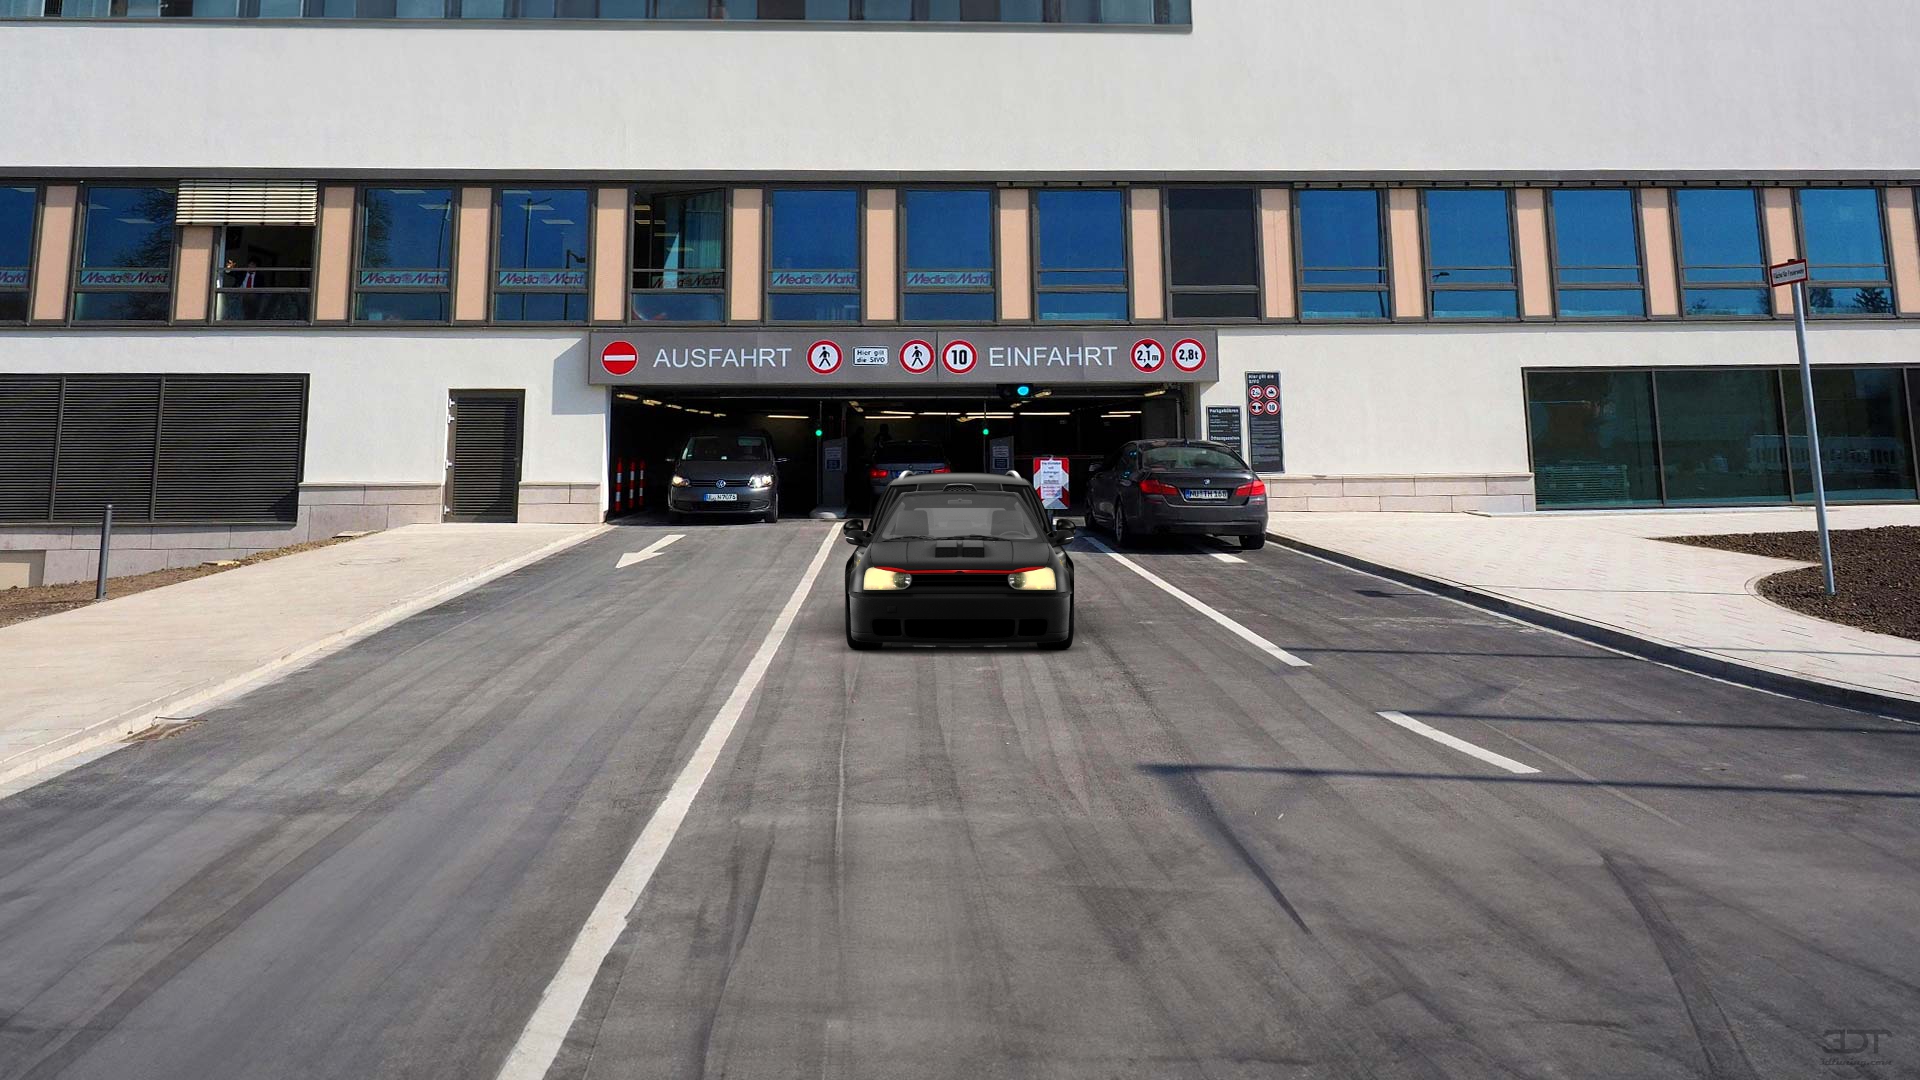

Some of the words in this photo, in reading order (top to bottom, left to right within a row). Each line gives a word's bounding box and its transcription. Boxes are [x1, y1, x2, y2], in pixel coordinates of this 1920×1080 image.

[81, 271, 121, 284] Media
[130, 271, 168, 284] Markt
[362, 272, 401, 284] Media
[411, 272, 449, 284] Markt
[500, 272, 539, 284] Media
[549, 272, 584, 284] Markt
[773, 273, 812, 285] Media
[820, 273, 856, 285] Markt
[908, 273, 947, 285] Media
[955, 273, 990, 285] Markt
[652, 347, 792, 368] AUSFAHRT
[873, 349, 885, 357] gilt
[951, 349, 968, 366] 10
[989, 346, 1118, 367] EINFAHRT
